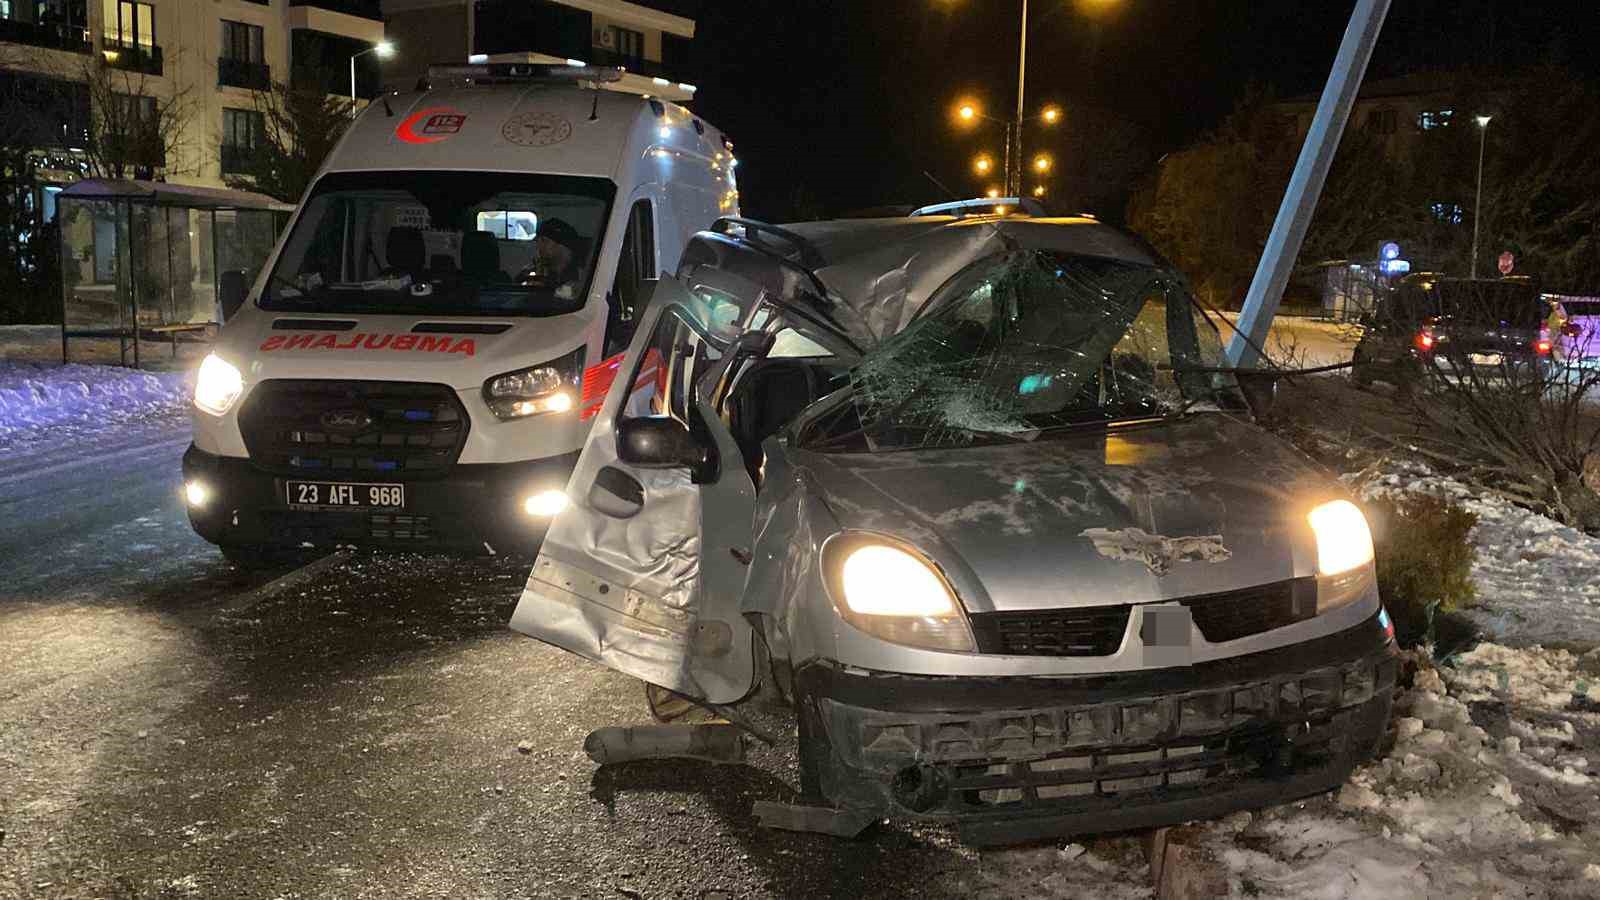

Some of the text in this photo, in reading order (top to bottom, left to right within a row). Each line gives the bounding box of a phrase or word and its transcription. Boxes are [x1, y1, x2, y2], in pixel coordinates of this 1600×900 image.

[433, 116, 460, 127] 112
[298, 484, 401, 506] 23 AFL 968
